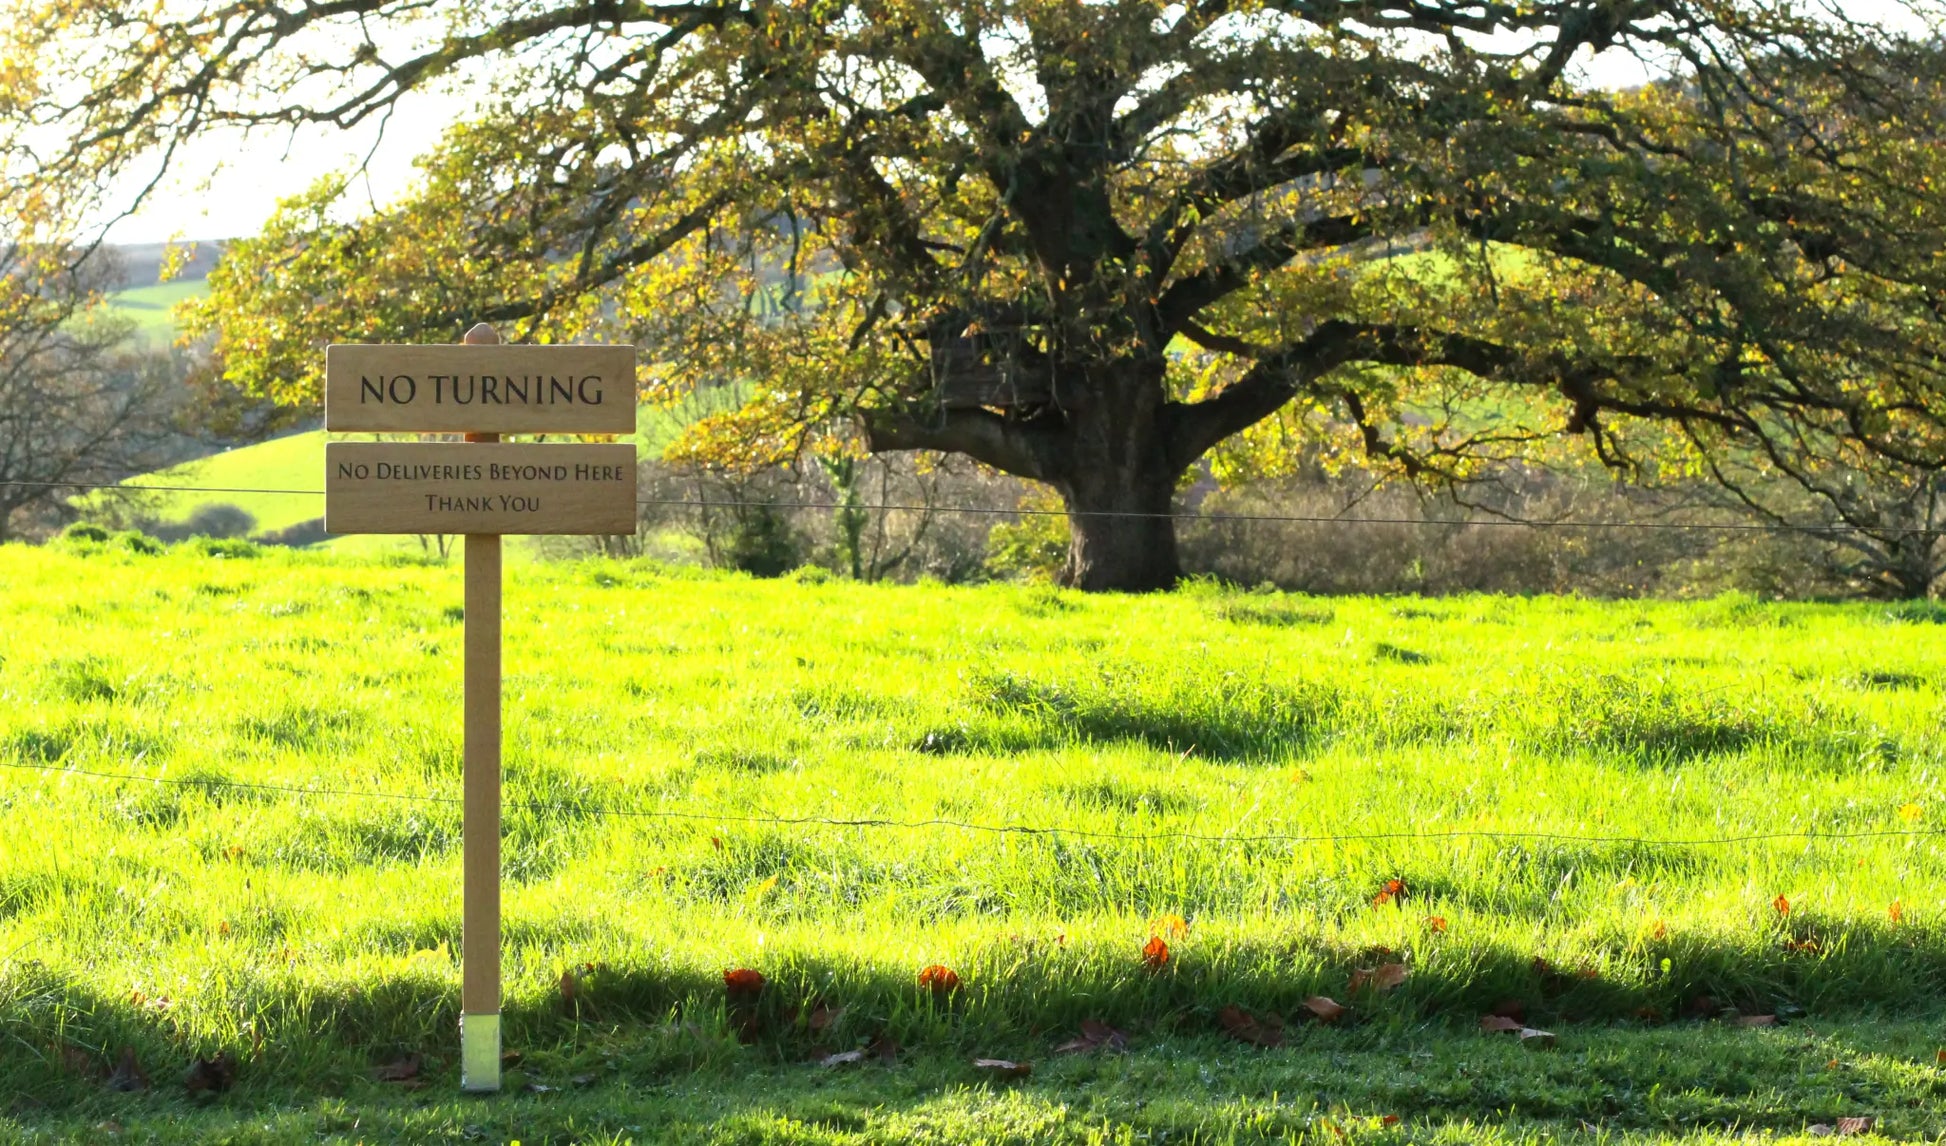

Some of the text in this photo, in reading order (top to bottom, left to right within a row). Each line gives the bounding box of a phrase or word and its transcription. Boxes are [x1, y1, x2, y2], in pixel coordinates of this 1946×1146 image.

[360, 375, 603, 405] NO TURNING
[338, 462, 623, 481] NO DELIVERIES BEYOND HERE
[424, 494, 540, 512] THANK YOU
